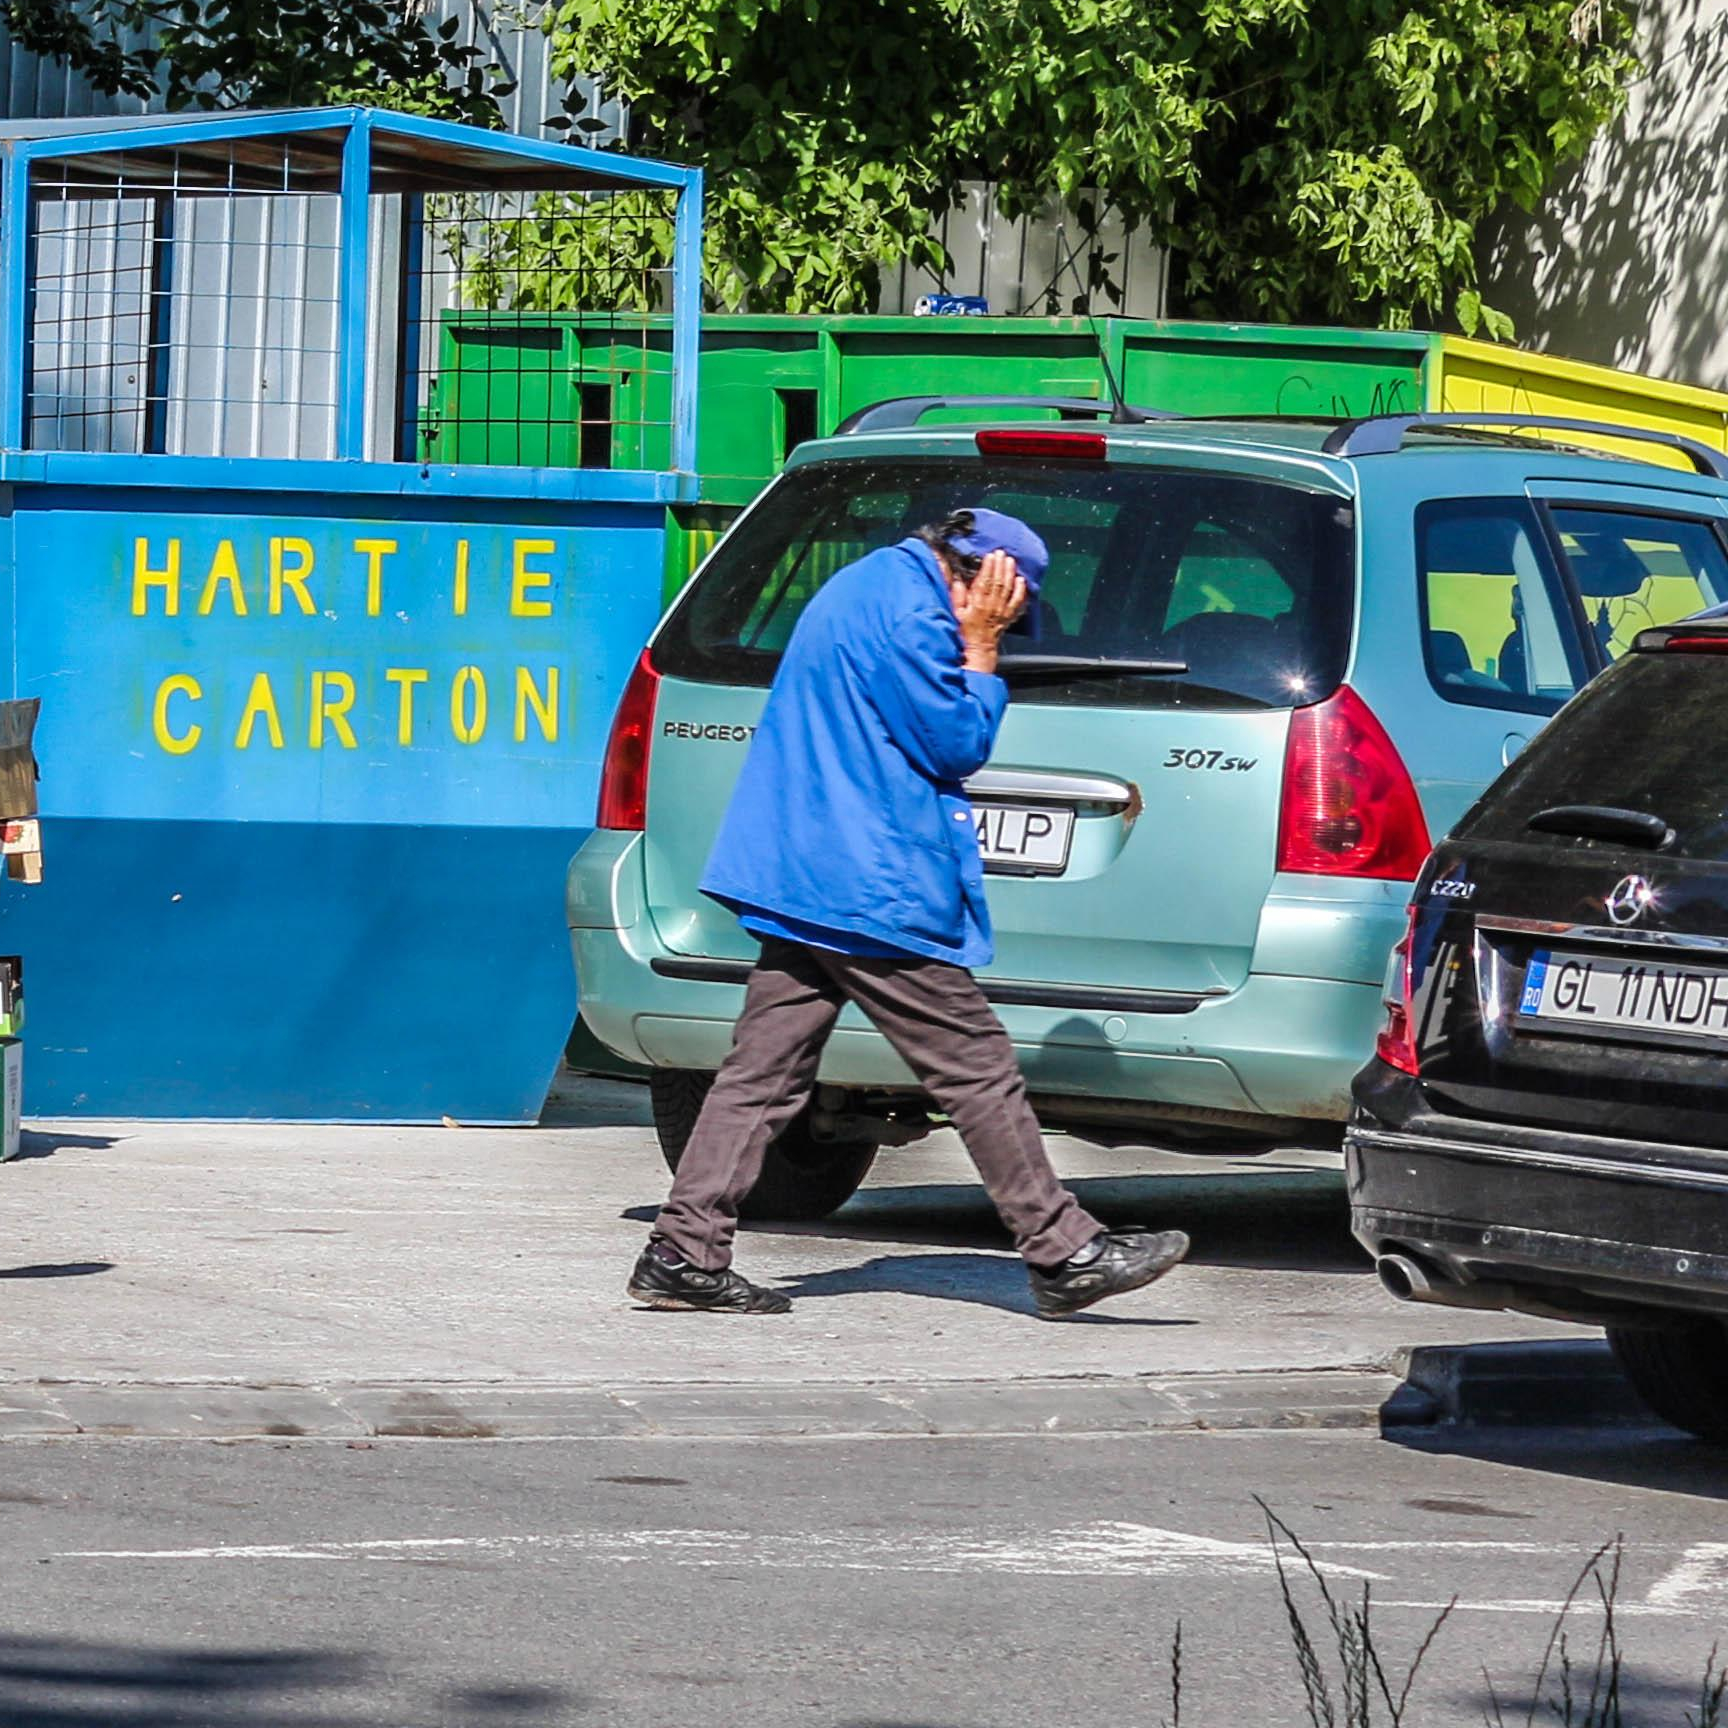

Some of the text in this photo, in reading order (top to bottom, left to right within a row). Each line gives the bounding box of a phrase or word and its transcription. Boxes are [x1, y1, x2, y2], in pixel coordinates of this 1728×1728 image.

[152, 665, 559, 755] CARTON
[1162, 748, 1225, 770] 307
[1523, 985, 1542, 1008] RO
[1554, 961, 1598, 1015] GL
